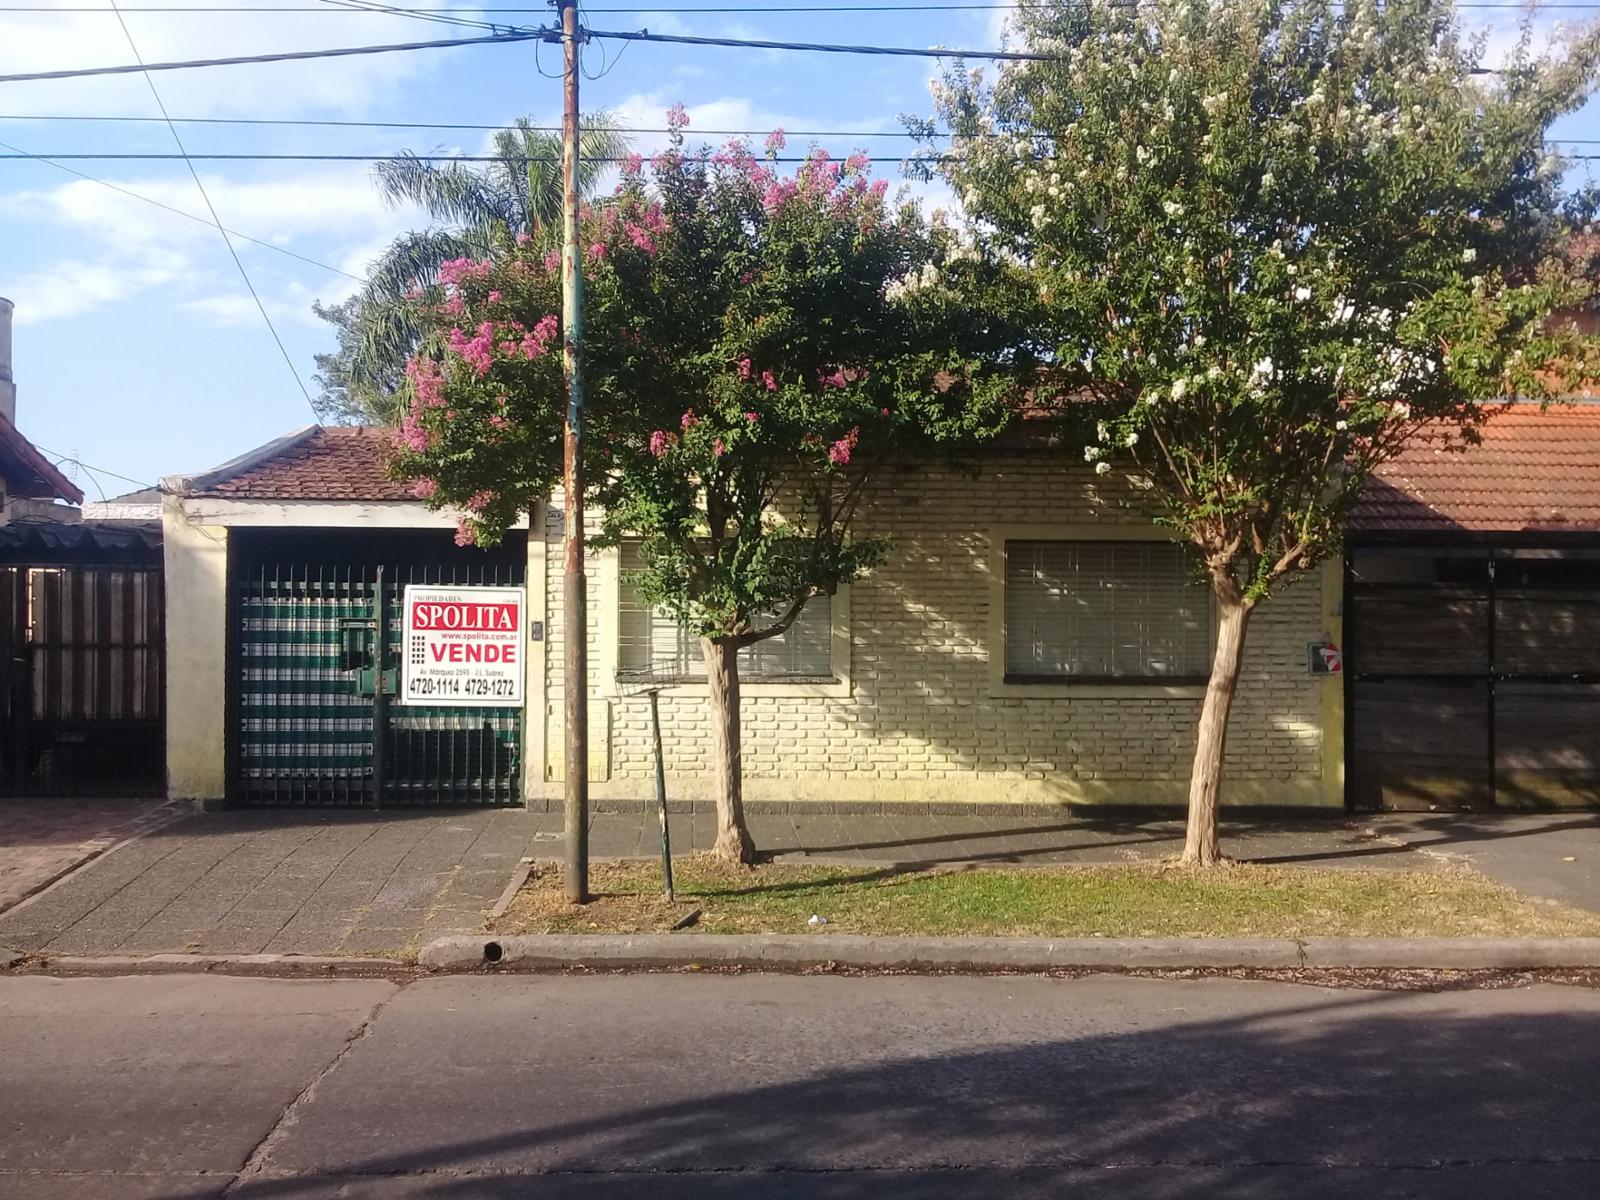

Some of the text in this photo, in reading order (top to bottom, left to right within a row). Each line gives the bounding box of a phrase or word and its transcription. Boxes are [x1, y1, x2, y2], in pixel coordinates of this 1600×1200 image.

[416, 604, 513, 629] SPOLITA
[441, 633, 518, 641] www.spolita.com.ar
[430, 643, 516, 663] VENDE
[410, 678, 514, 695] 4720-1114 4729-1272
